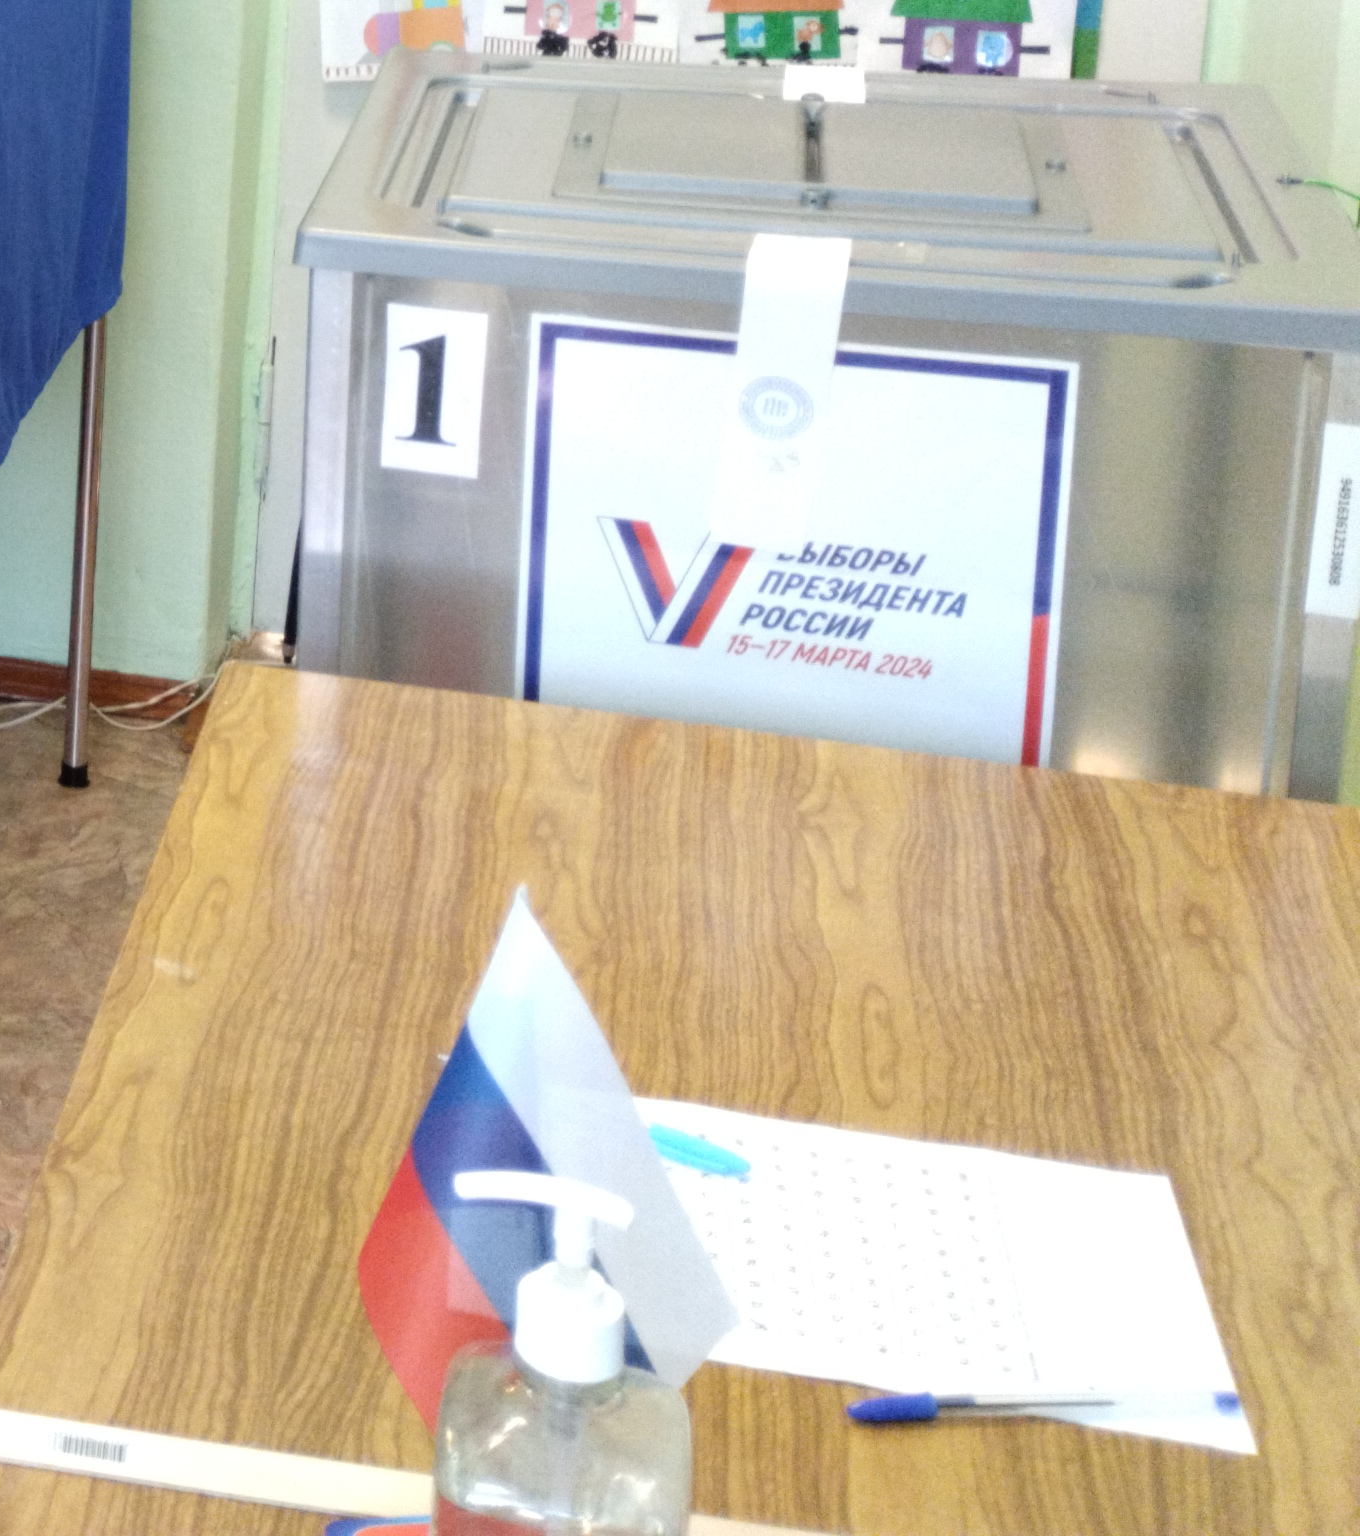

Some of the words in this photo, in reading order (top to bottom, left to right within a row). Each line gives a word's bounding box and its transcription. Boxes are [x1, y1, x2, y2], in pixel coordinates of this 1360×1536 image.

[394, 333, 457, 448] 1
[757, 569, 968, 619] ПРЕЗИДЕНТА
[739, 602, 875, 642] РОССИИ
[791, 642, 872, 671] МАРТА
[875, 653, 933, 680] 2024
